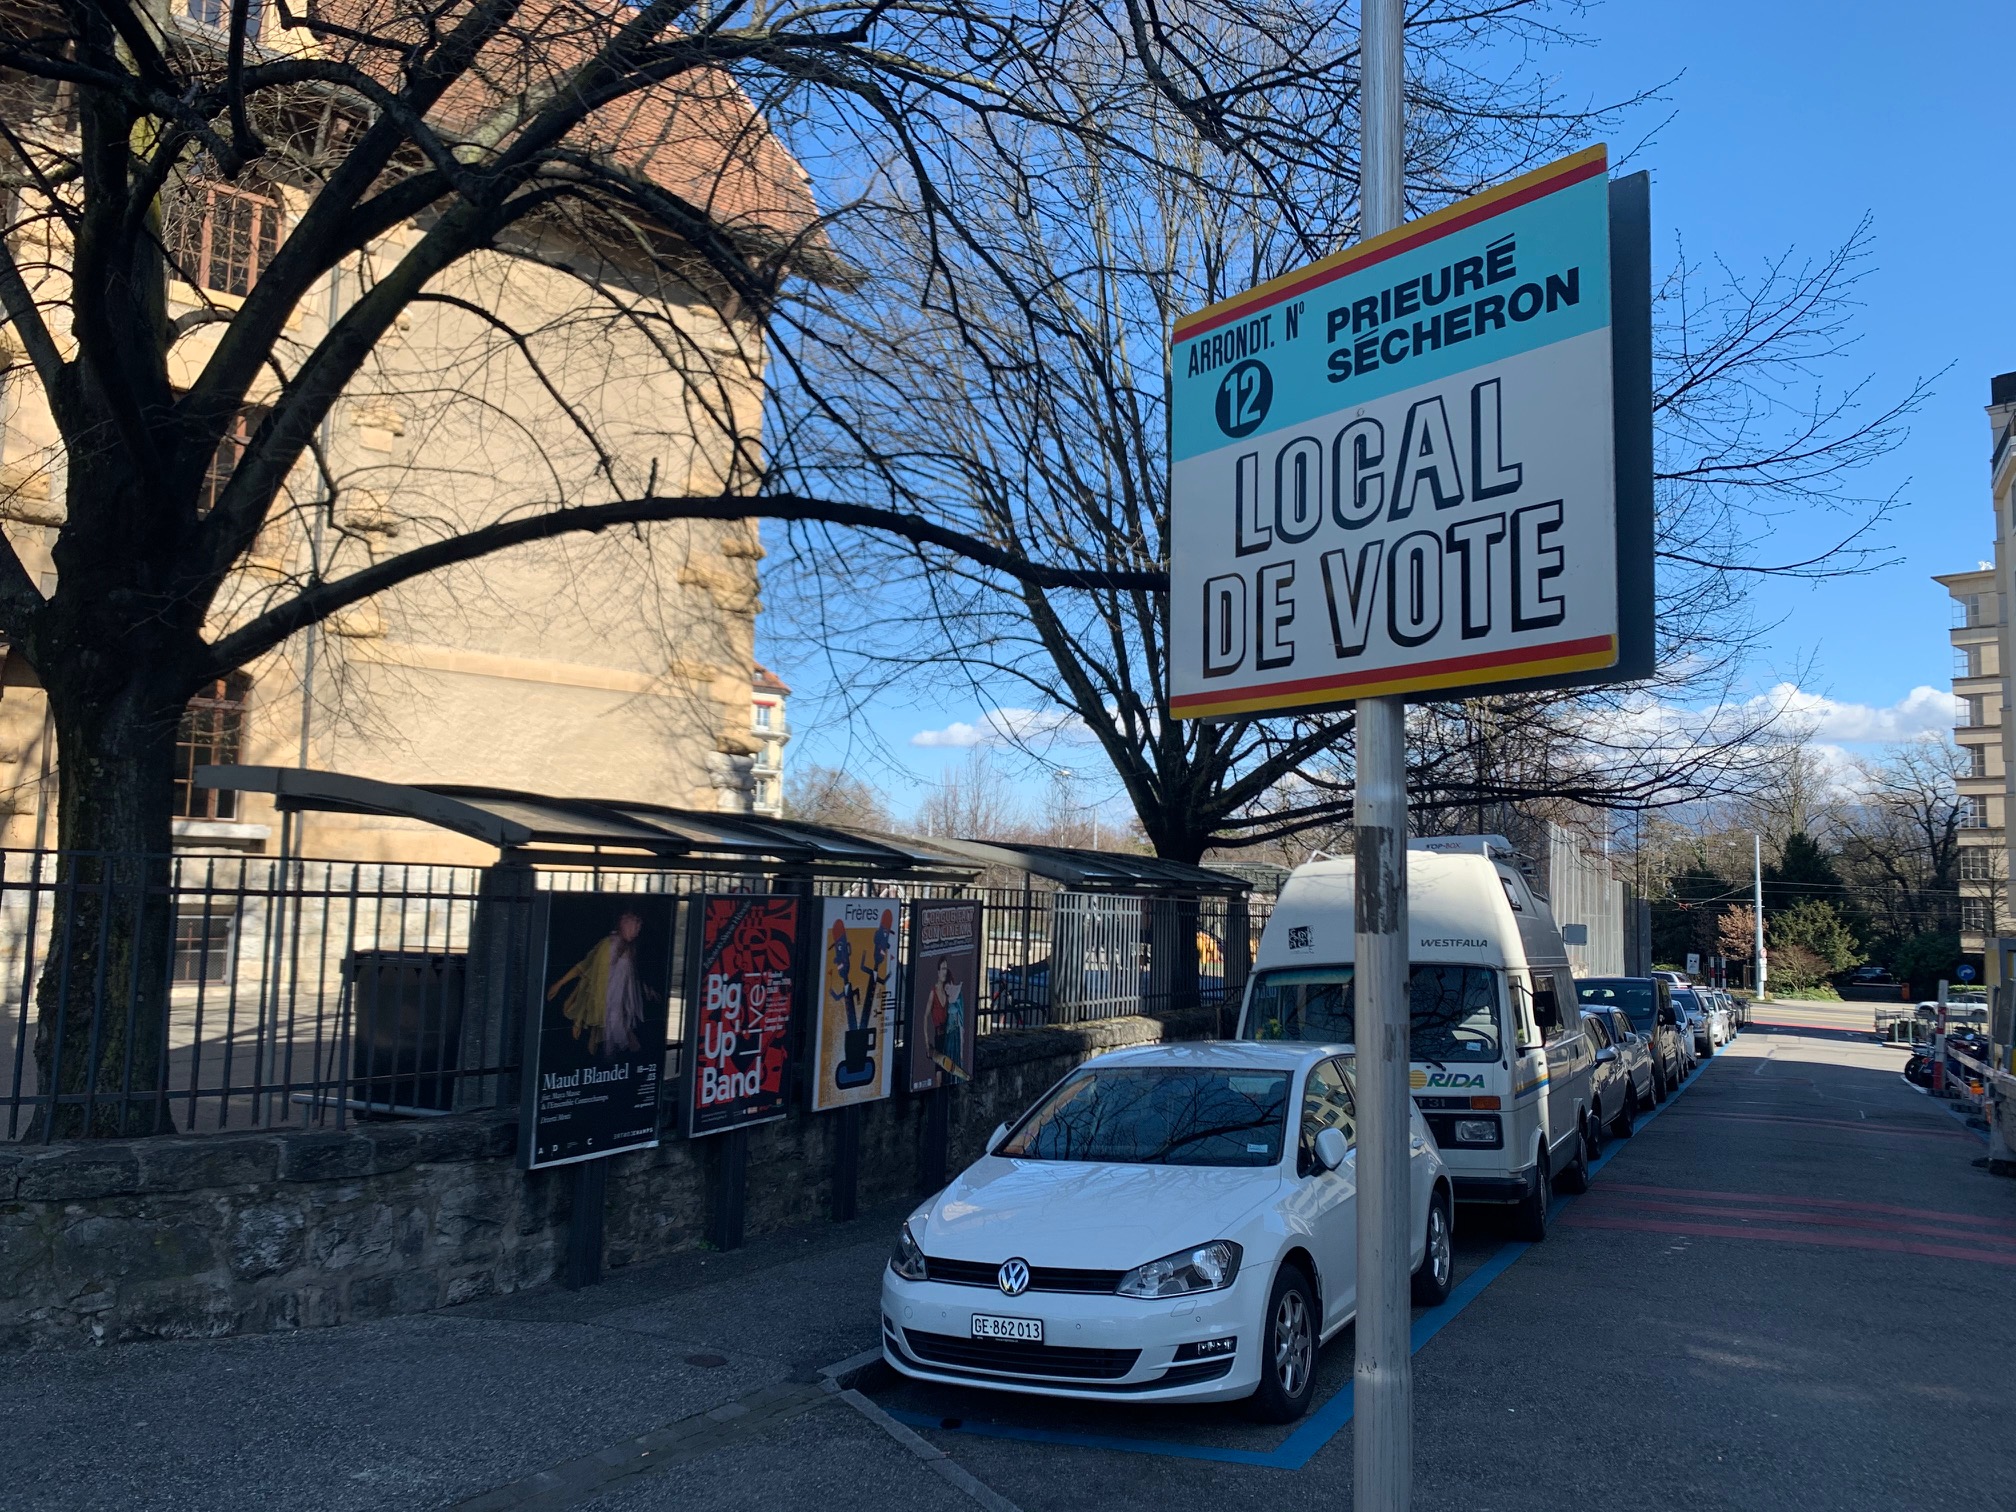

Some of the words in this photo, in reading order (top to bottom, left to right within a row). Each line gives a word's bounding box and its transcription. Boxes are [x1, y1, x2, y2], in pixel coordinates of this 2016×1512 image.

[1326, 233, 1516, 343] PRIEURÉ
[1326, 267, 1580, 384] SÉCHERON
[1224, 366, 1263, 429] 12
[1235, 377, 1522, 558] LOCAL
[1203, 560, 1295, 679] DE
[1319, 499, 1566, 659] VOTE
[845, 903, 879, 922] Frères
[1421, 938, 1488, 948] WESTFALIA
[706, 973, 742, 1020] Big
[739, 972, 767, 1056] Live!
[542, 1068, 579, 1091] Maud
[582, 1062, 630, 1085] Blandel
[701, 1056, 761, 1104] Band
